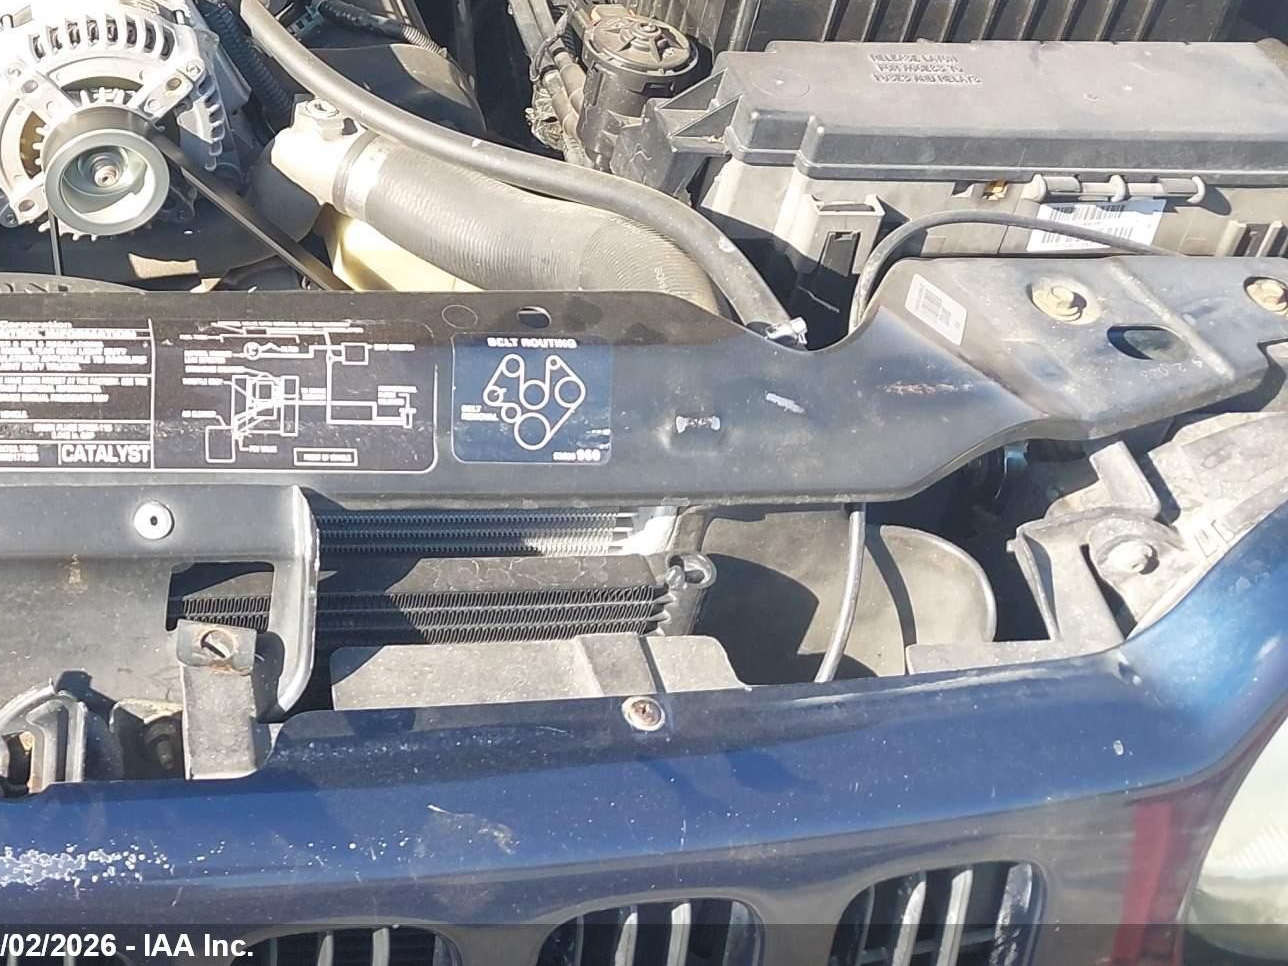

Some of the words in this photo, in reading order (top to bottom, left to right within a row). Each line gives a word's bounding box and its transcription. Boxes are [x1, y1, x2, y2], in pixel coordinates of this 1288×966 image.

[487, 337, 519, 348] BELT
[520, 337, 578, 349] ROUTING
[61, 444, 150, 463] CATALYST
